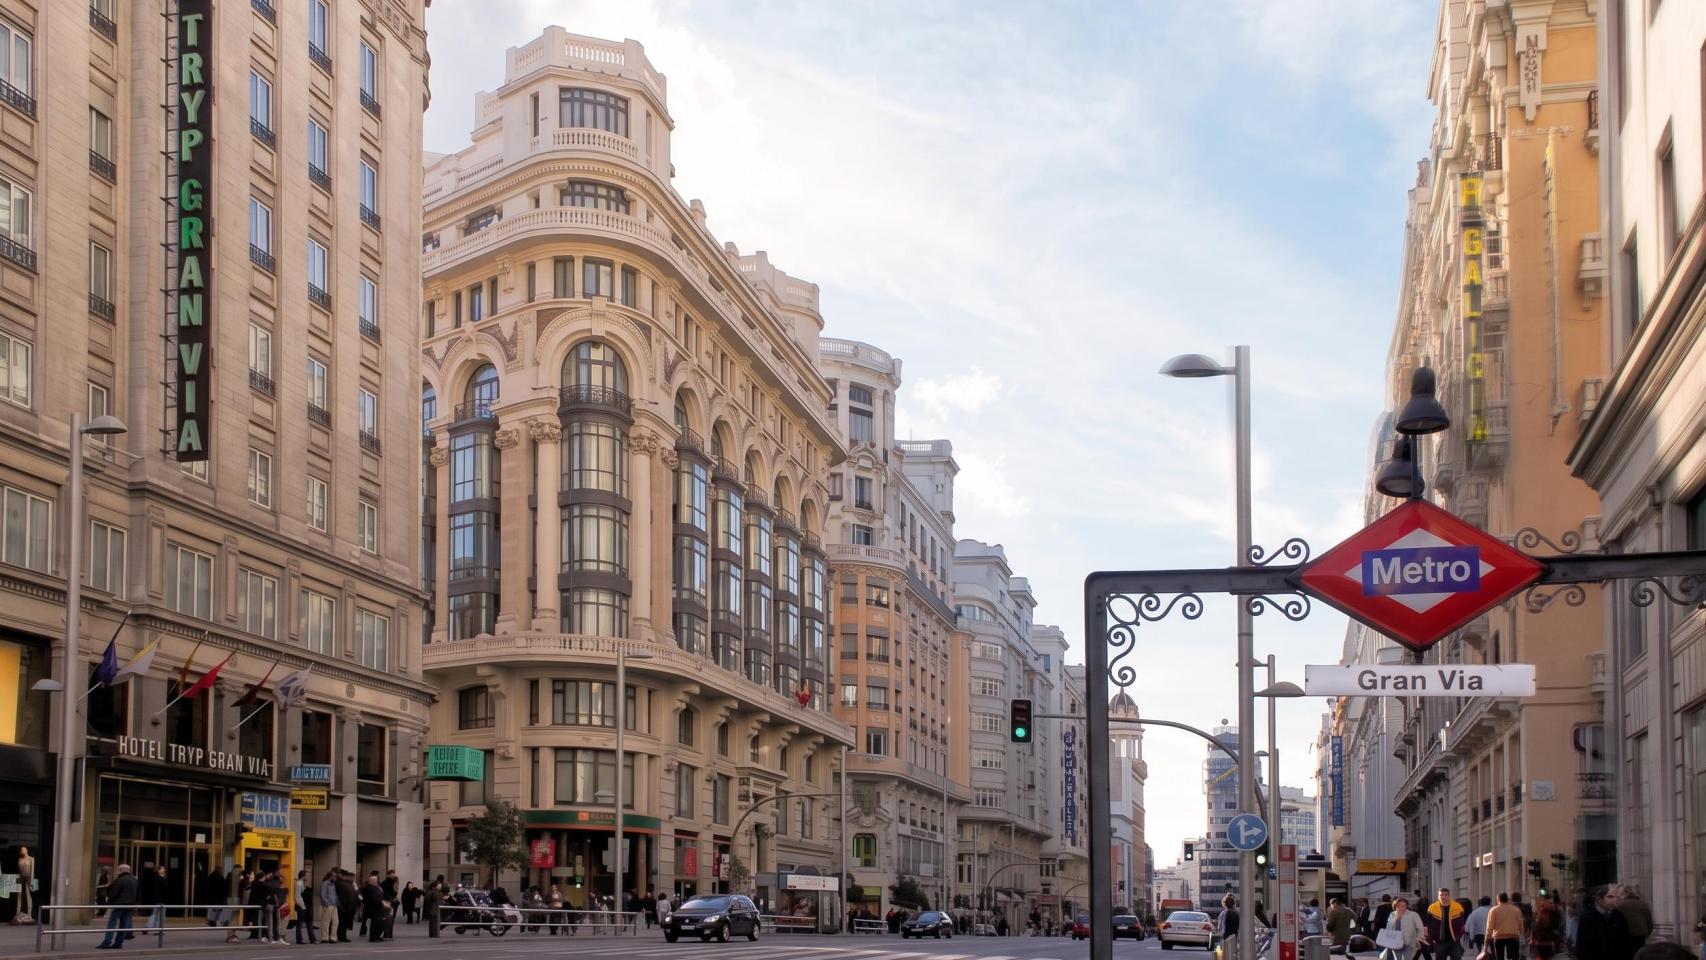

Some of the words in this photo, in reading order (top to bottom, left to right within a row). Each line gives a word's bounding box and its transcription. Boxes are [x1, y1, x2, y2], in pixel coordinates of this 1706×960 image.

[180, 13, 206, 163] TRYP
[179, 178, 205, 327] GRAN
[177, 342, 204, 452] VIA
[1372, 556, 1472, 585] Metro
[1358, 669, 1427, 691] Gran
[1438, 669, 1484, 691] Via
[119, 735, 165, 761] HOTEL
[169, 743, 204, 766] TRYP
[208, 750, 243, 773] GRAN
[248, 756, 269, 777] VIA
